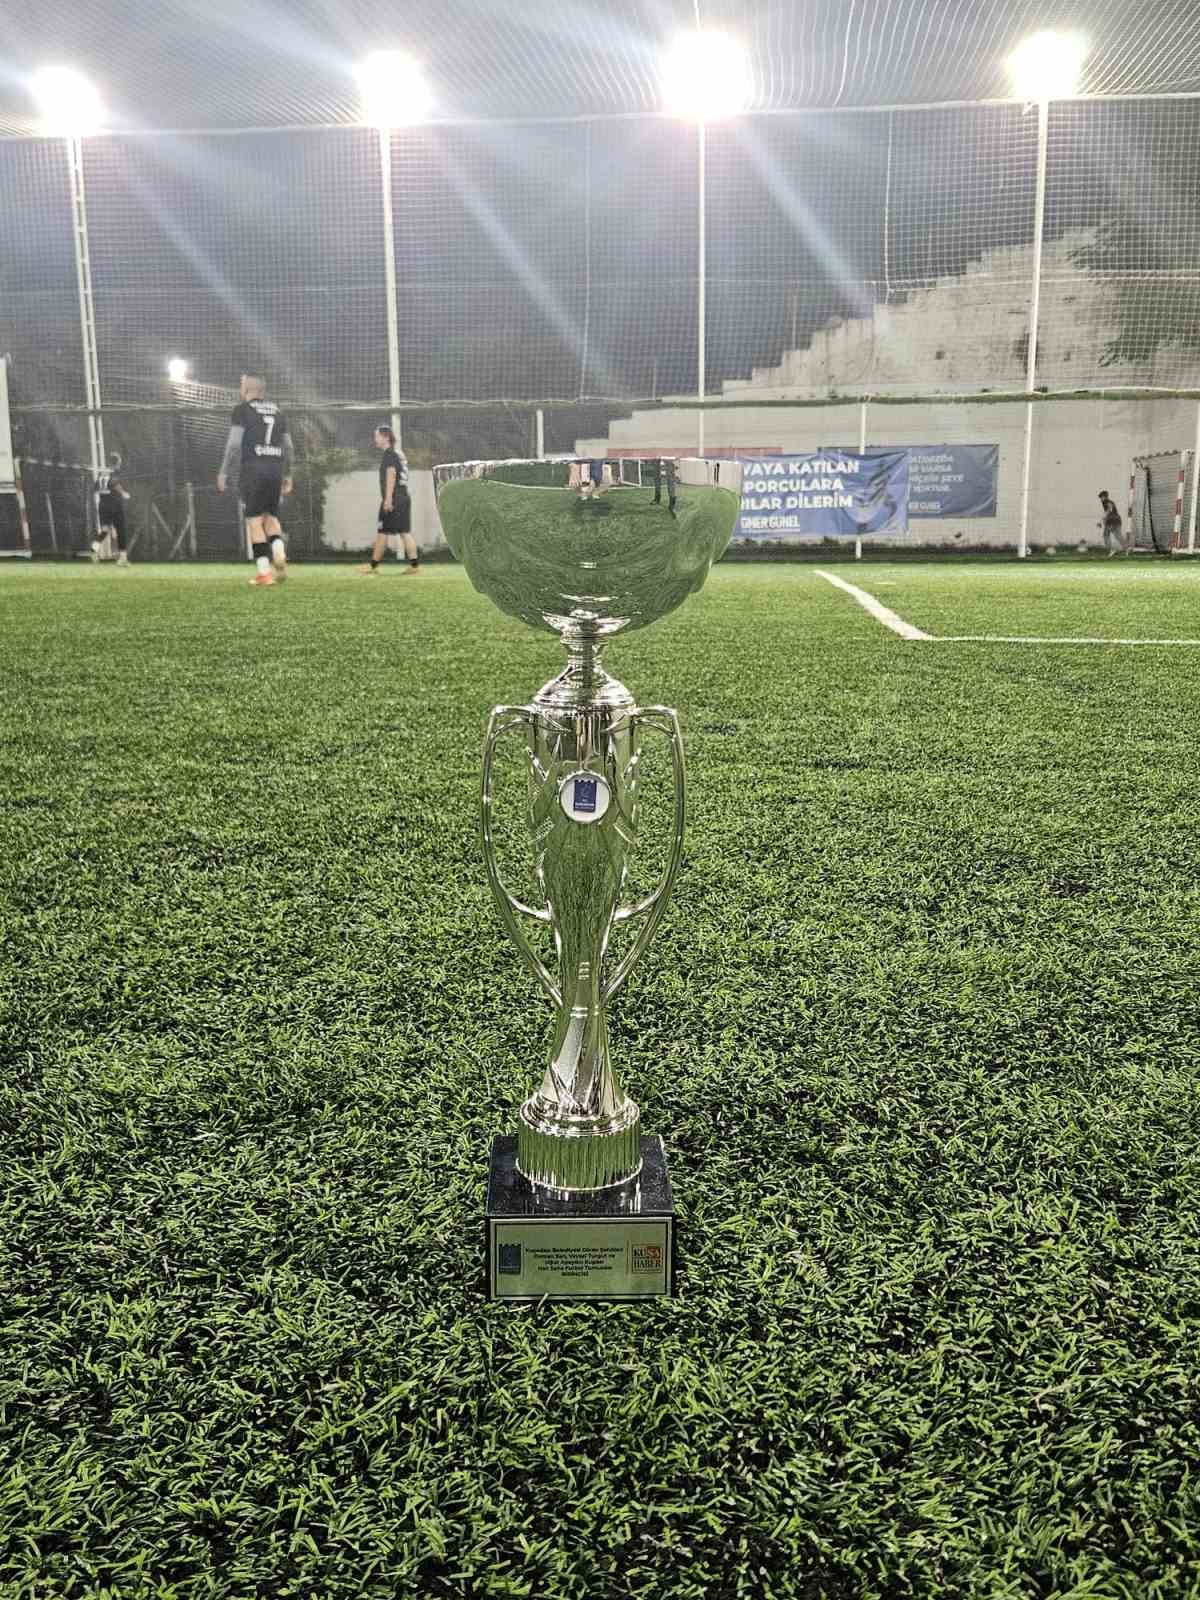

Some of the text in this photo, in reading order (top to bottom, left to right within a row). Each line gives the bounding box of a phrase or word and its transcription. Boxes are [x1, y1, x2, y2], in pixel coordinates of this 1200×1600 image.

[263, 415, 275, 444] 7
[789, 460, 859, 474] KATILAN
[743, 478, 844, 493] PORCULARA
[786, 492, 853, 508] DİLERİM
